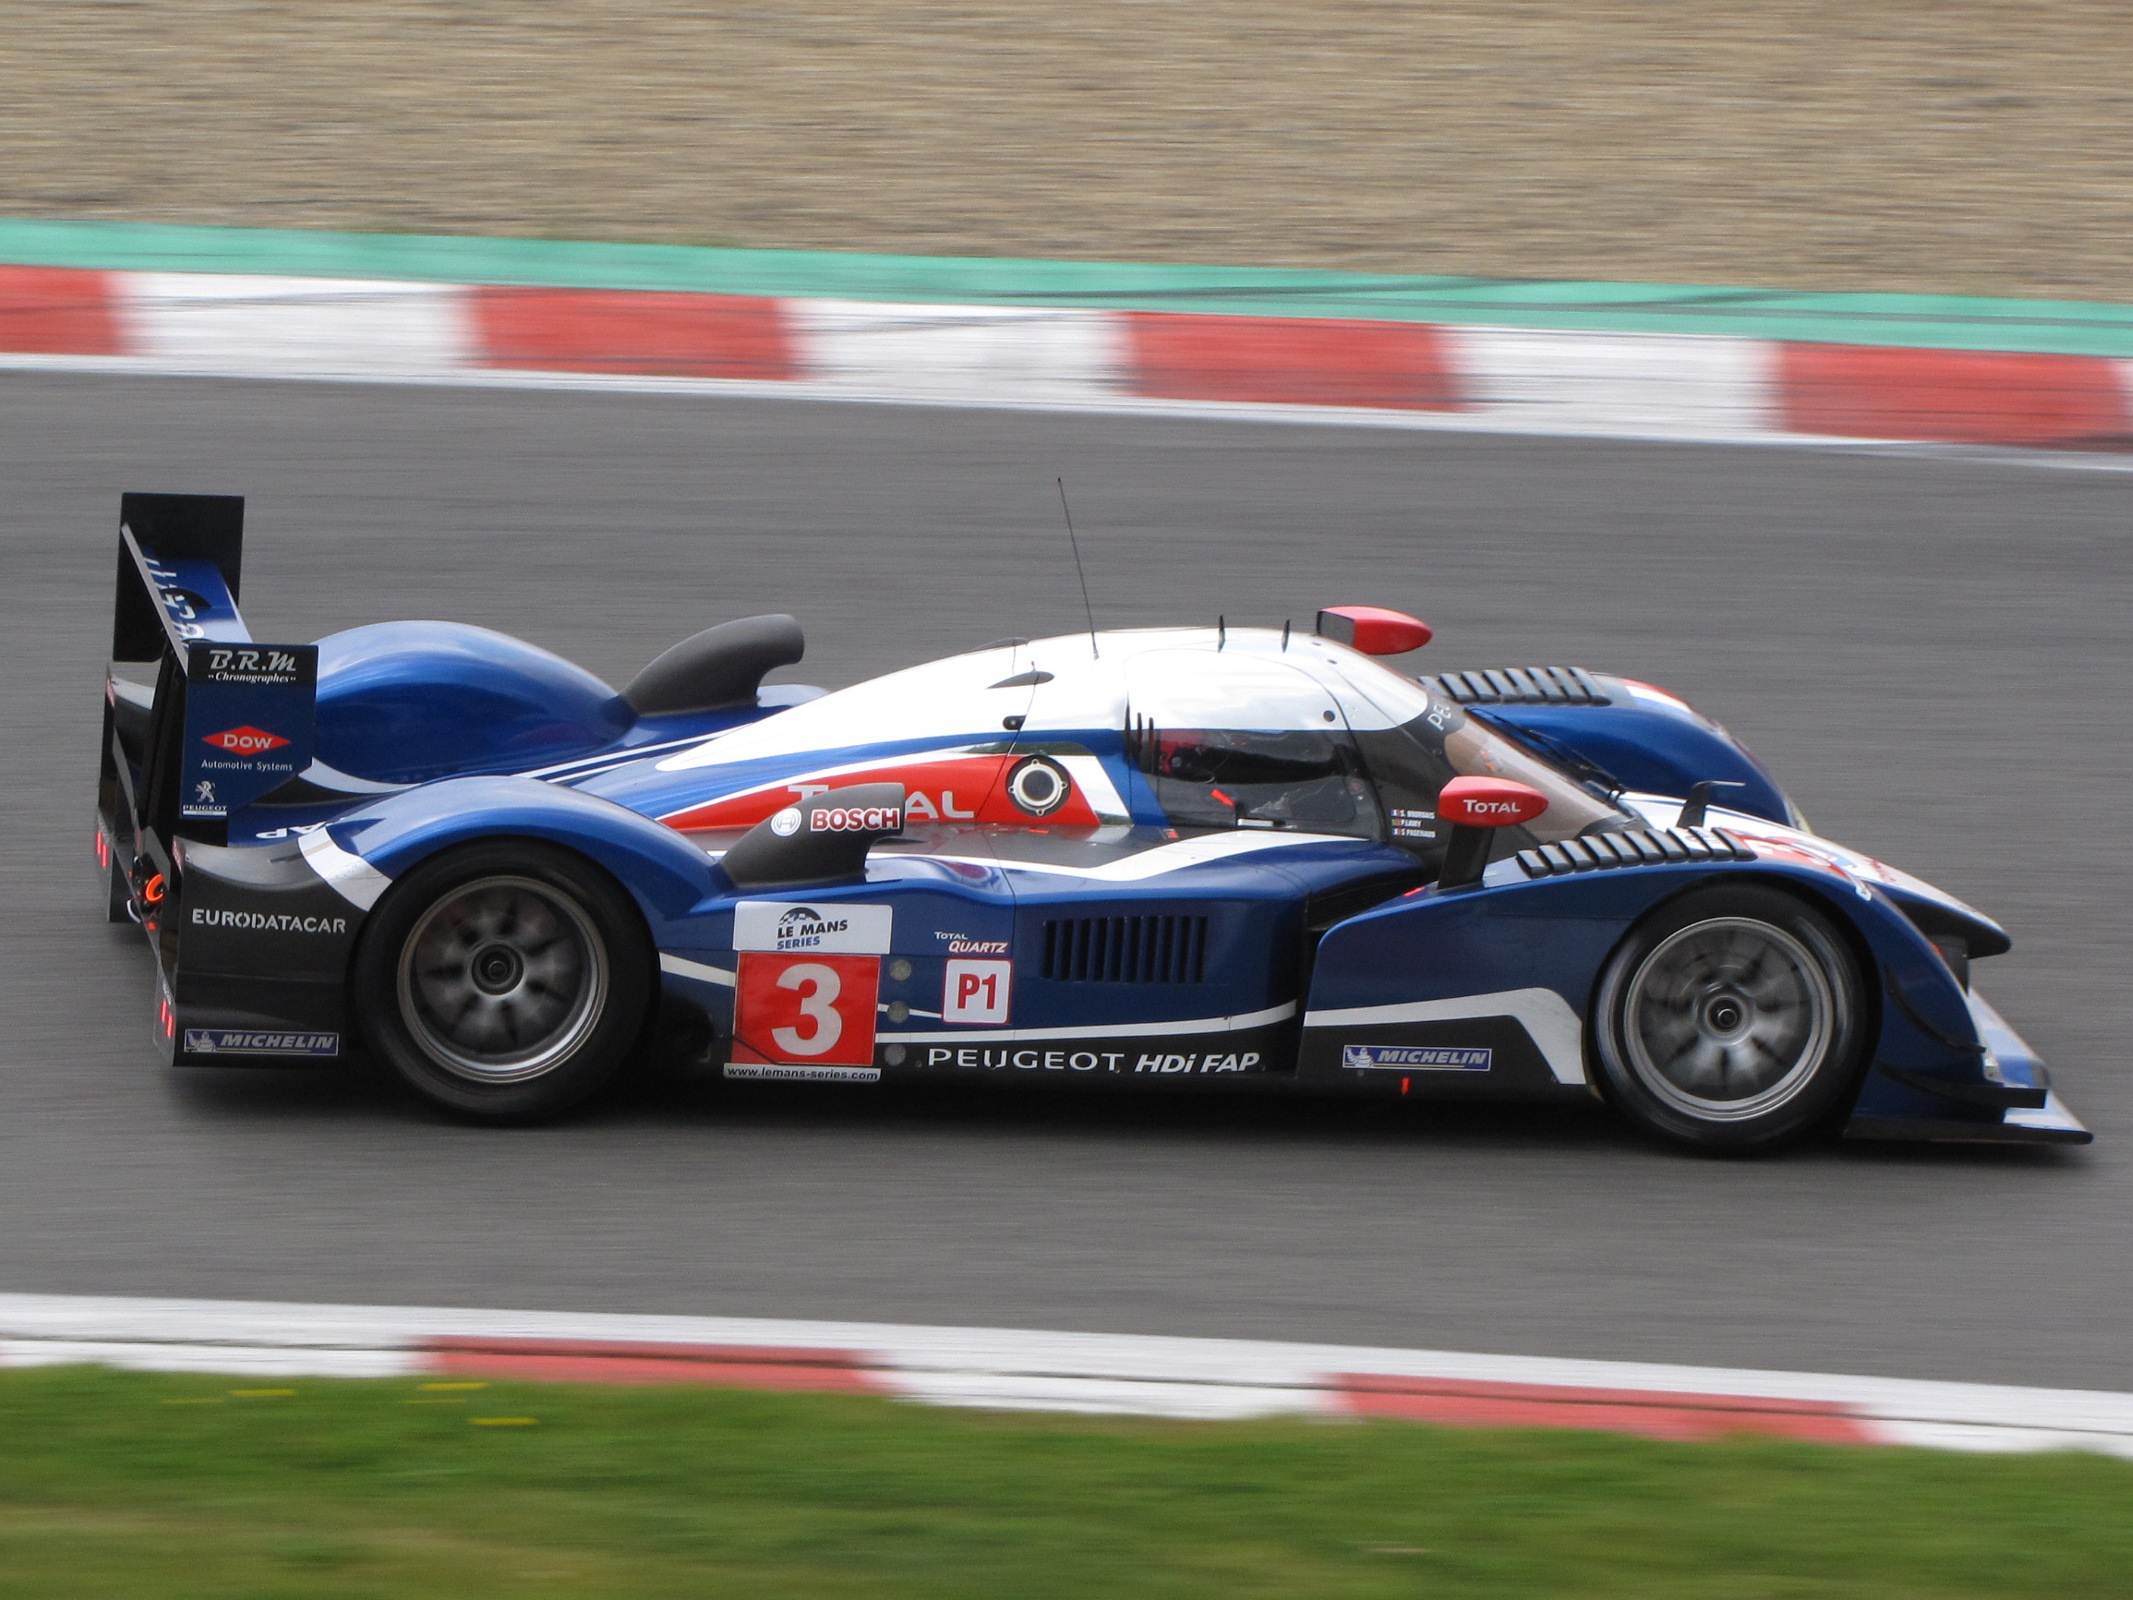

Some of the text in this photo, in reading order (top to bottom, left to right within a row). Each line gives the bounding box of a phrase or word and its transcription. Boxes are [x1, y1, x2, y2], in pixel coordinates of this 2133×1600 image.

[201, 759, 293, 772] Automotive Systems
[787, 784, 975, 819] TAL
[1462, 799, 1521, 813] TOTAL
[811, 807, 900, 832] BOSCH
[192, 908, 346, 933] EURODATACAR
[777, 919, 848, 939] LE MANS
[934, 931, 968, 940] TOTAL
[776, 935, 821, 950] SERIES
[948, 940, 1008, 954] QUARTZ
[957, 973, 997, 1010] P1
[771, 962, 843, 1057] 3
[220, 1034, 335, 1049] MICHELIN
[927, 1047, 1260, 1073] PEUGEOT HDi FAP
[1377, 1050, 1487, 1065] MICHELIN
[727, 1066, 878, 1081] www.lemans-series.com
